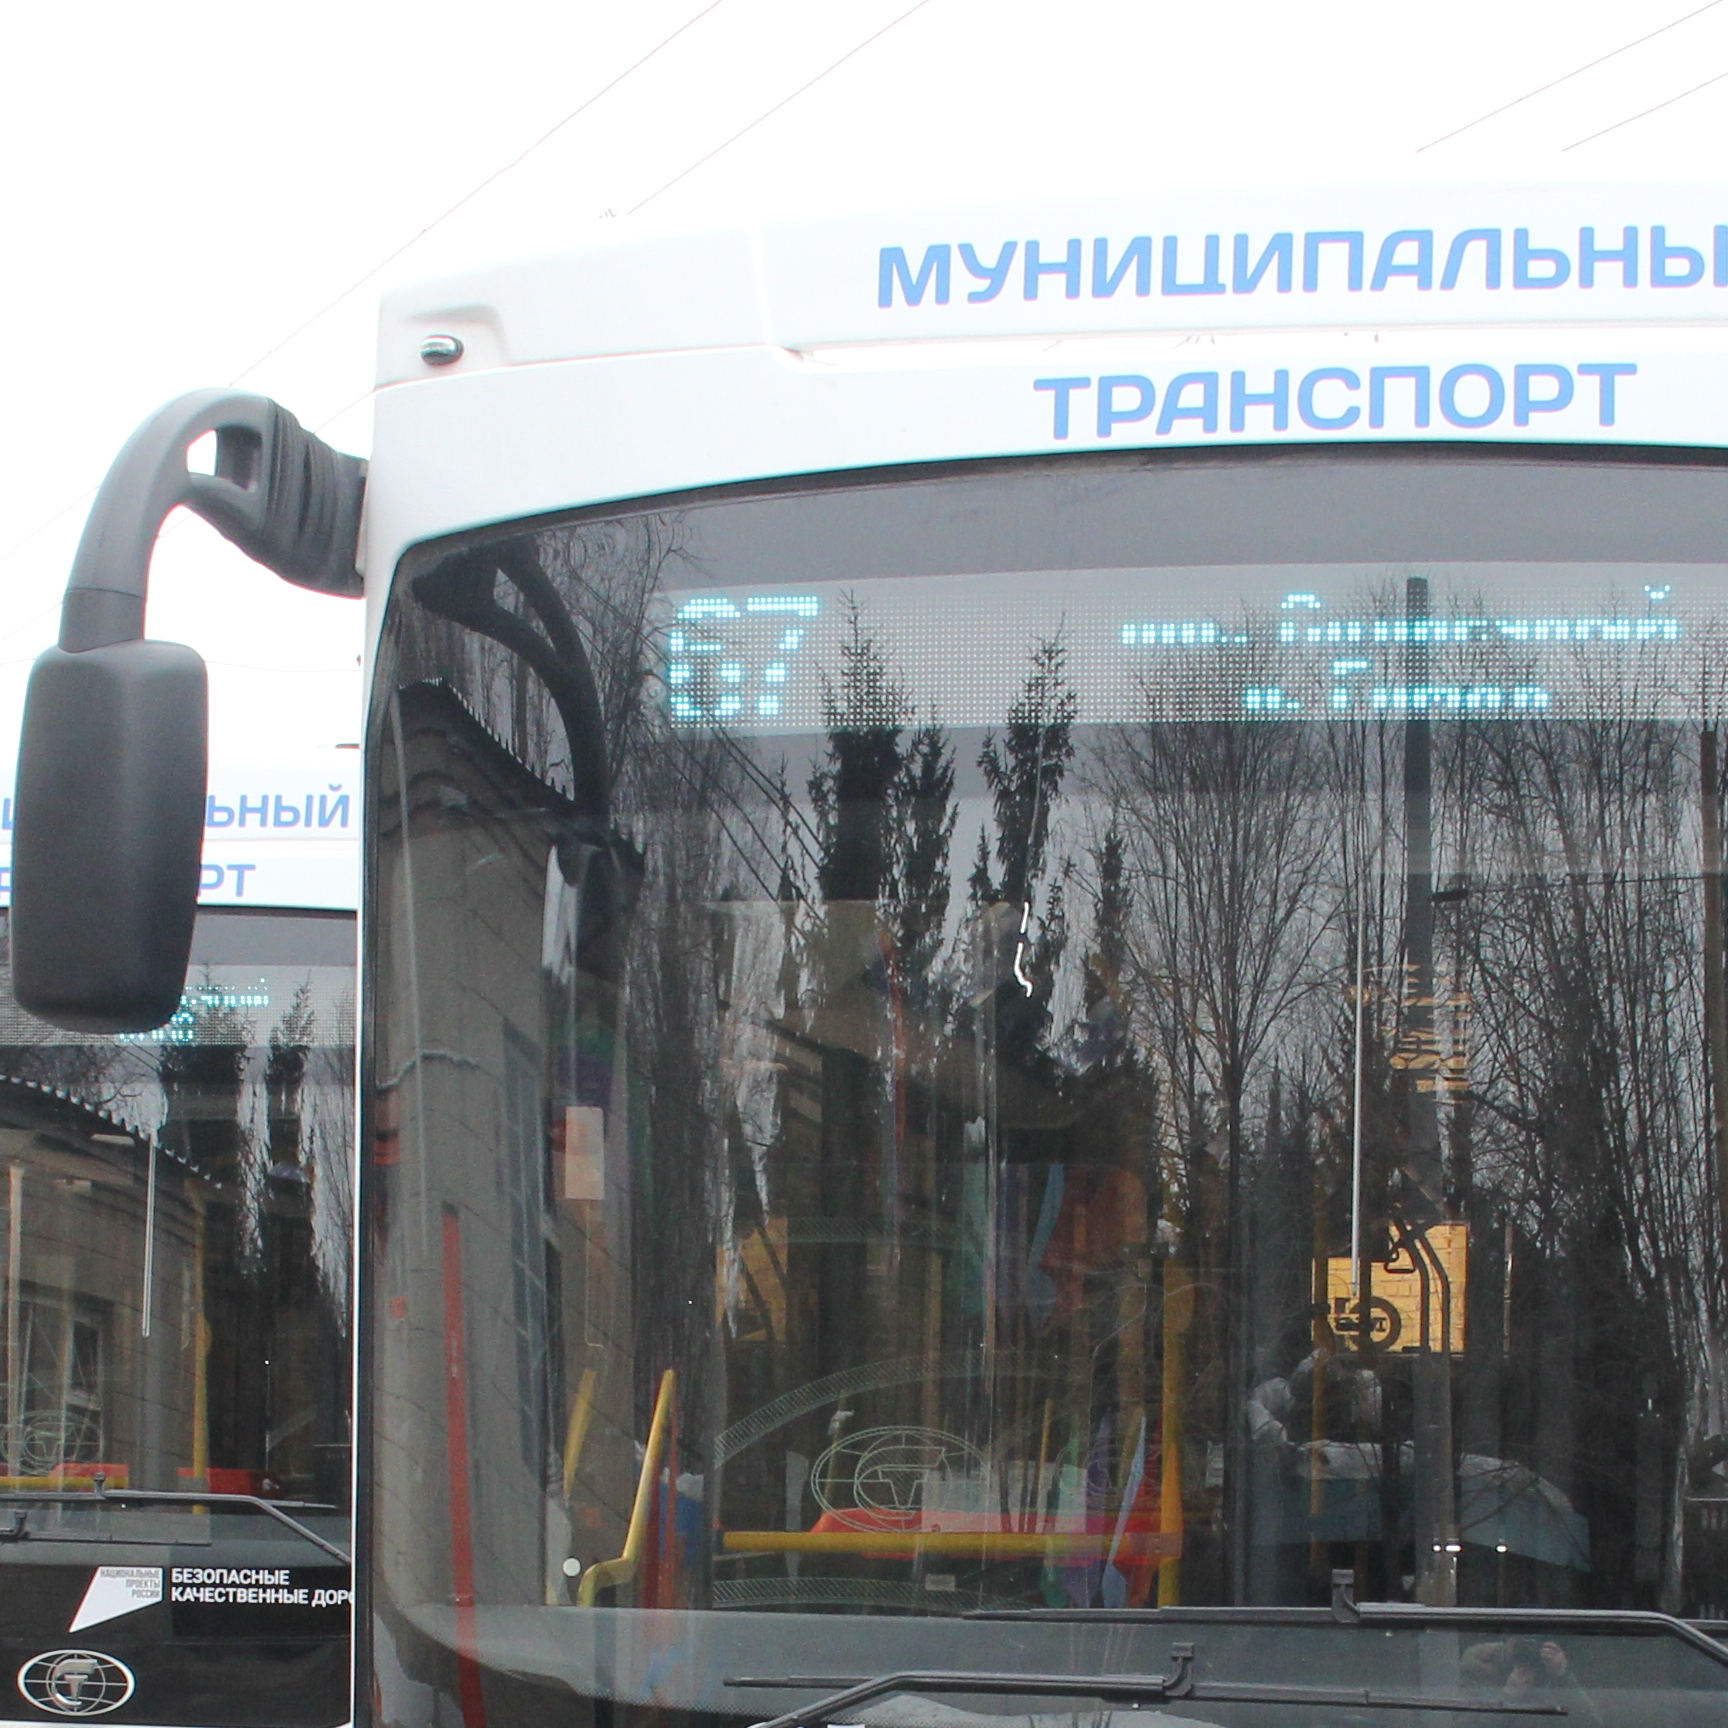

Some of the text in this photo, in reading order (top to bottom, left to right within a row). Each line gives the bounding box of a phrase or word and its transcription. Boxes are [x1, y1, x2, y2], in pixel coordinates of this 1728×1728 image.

[1033, 363, 1638, 440] ТРАНСПОРТ
[671, 596, 819, 716] 67
[171, 1568, 290, 1585] БЕЗОПАСНЫЕ
[171, 1587, 309, 1604] КАЧЕСТВЕННЫЕ
